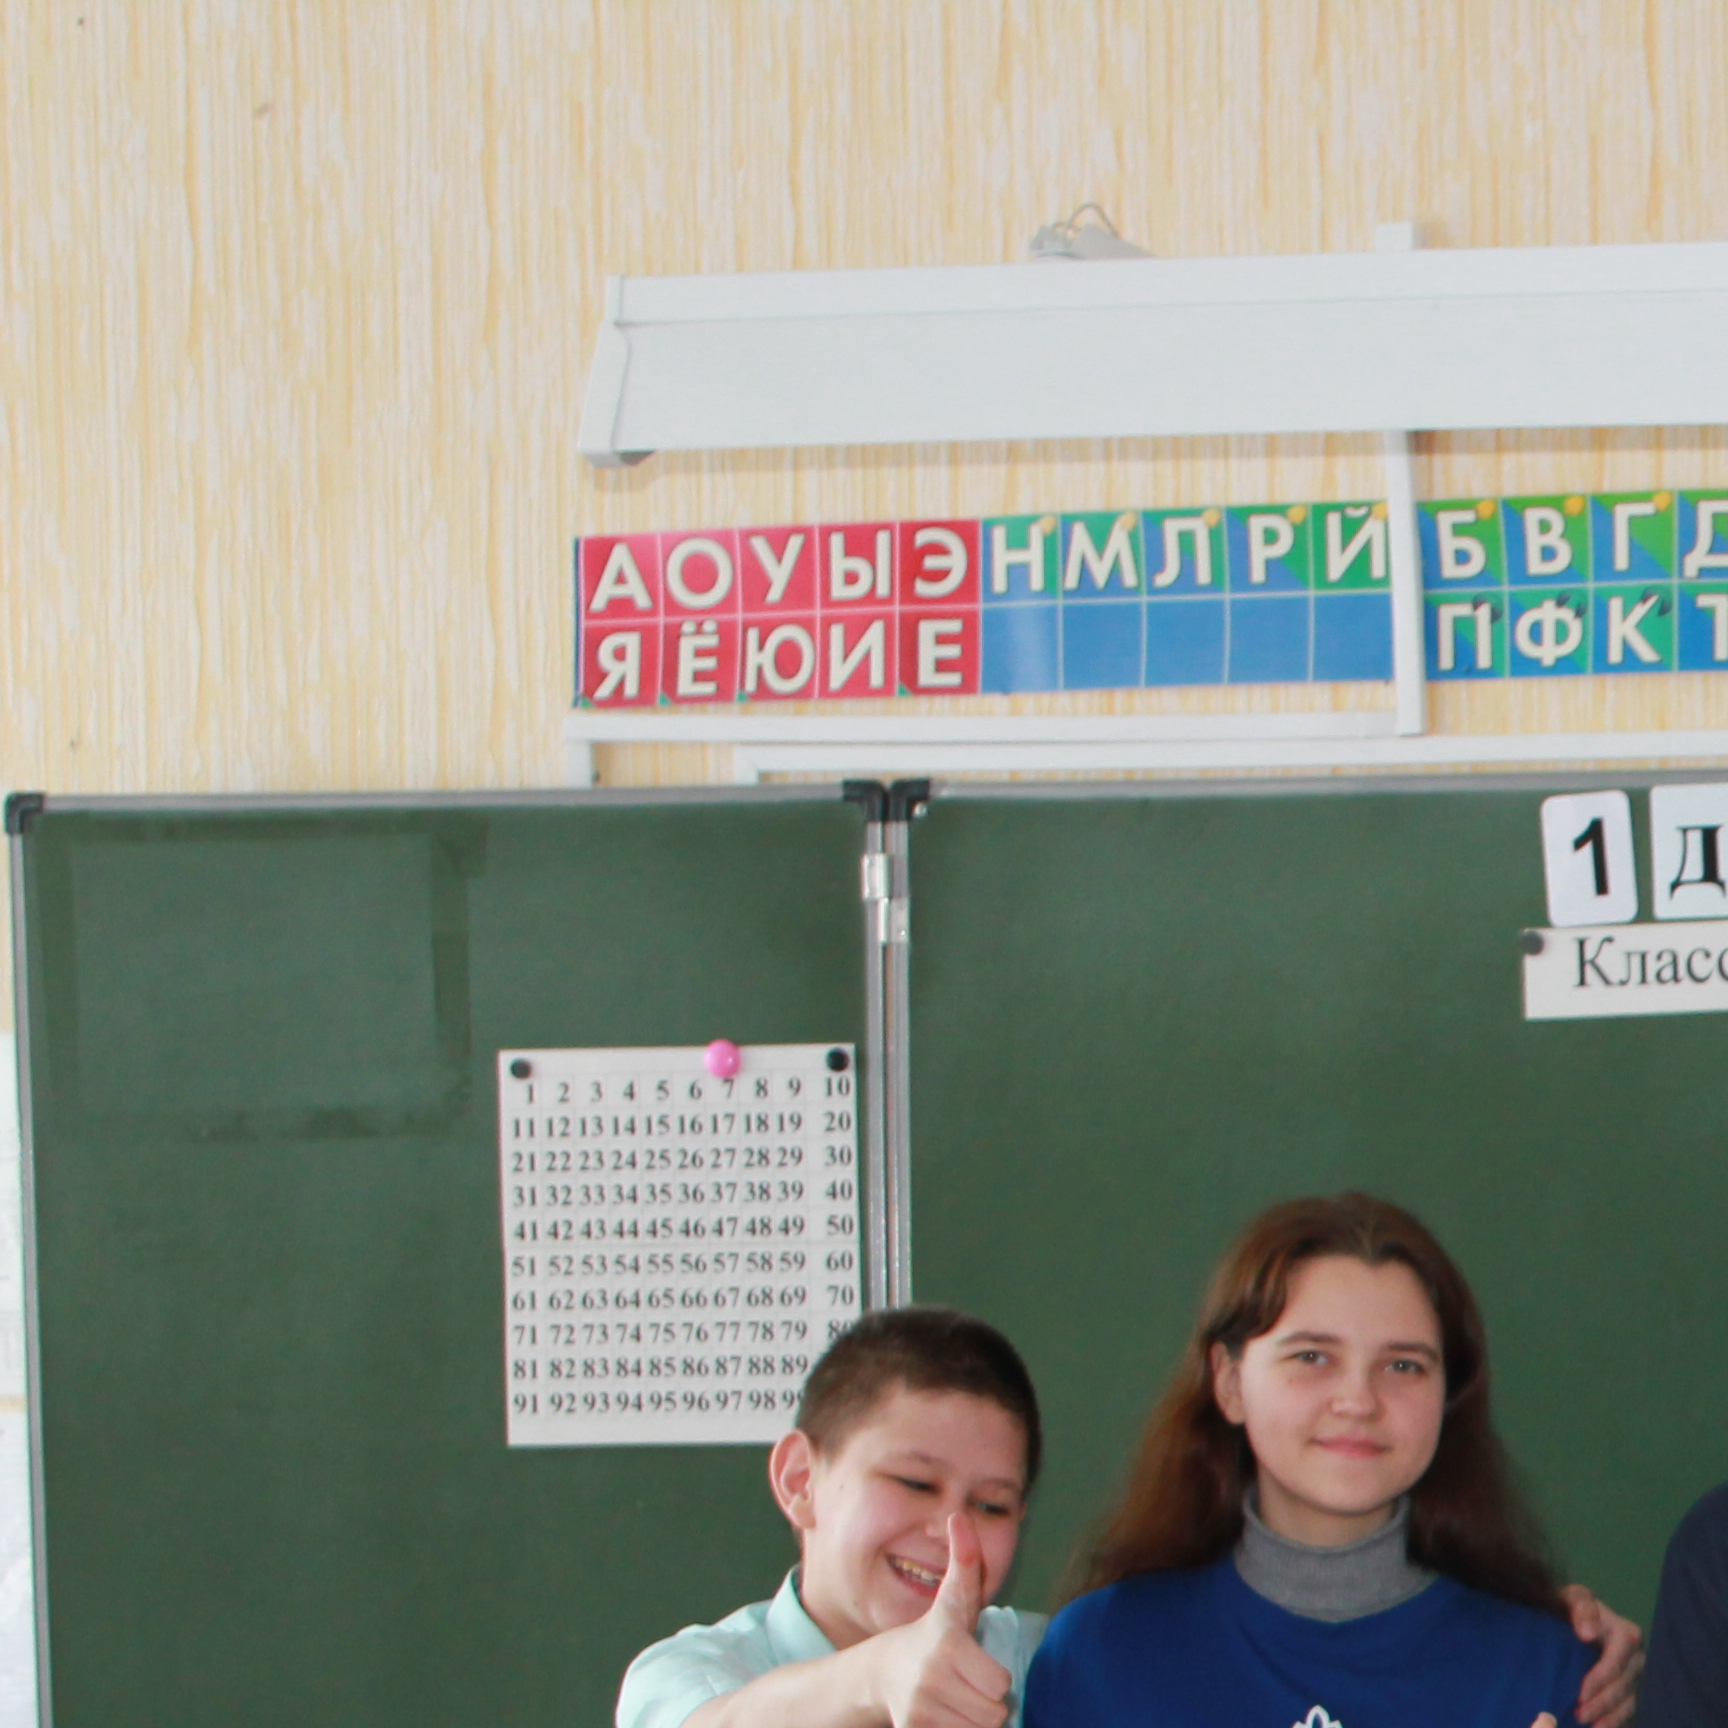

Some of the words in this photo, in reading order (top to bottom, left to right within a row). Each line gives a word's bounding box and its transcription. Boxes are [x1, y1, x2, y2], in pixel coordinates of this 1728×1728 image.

[1572, 817, 1610, 897] 1
[527, 1083, 534, 1103] 1
[558, 1082, 569, 1102] 2
[591, 1081, 603, 1102] 3
[623, 1080, 635, 1100] 4
[657, 1080, 670, 1101] 5
[690, 1080, 702, 1099] 6
[723, 1078, 734, 1098] 7
[755, 1078, 768, 1098] 8
[788, 1077, 801, 1096] 9
[825, 1076, 850, 1097] 10
[514, 1117, 535, 1138] 11
[547, 1116, 570, 1137] 12
[580, 1116, 603, 1136] 13
[613, 1115, 636, 1136] 14
[646, 1114, 670, 1136] 15
[678, 1114, 703, 1134] 16
[711, 1113, 736, 1134] 17
[744, 1112, 769, 1133] 18
[777, 1112, 802, 1132] 19
[824, 1111, 851, 1131] 20
